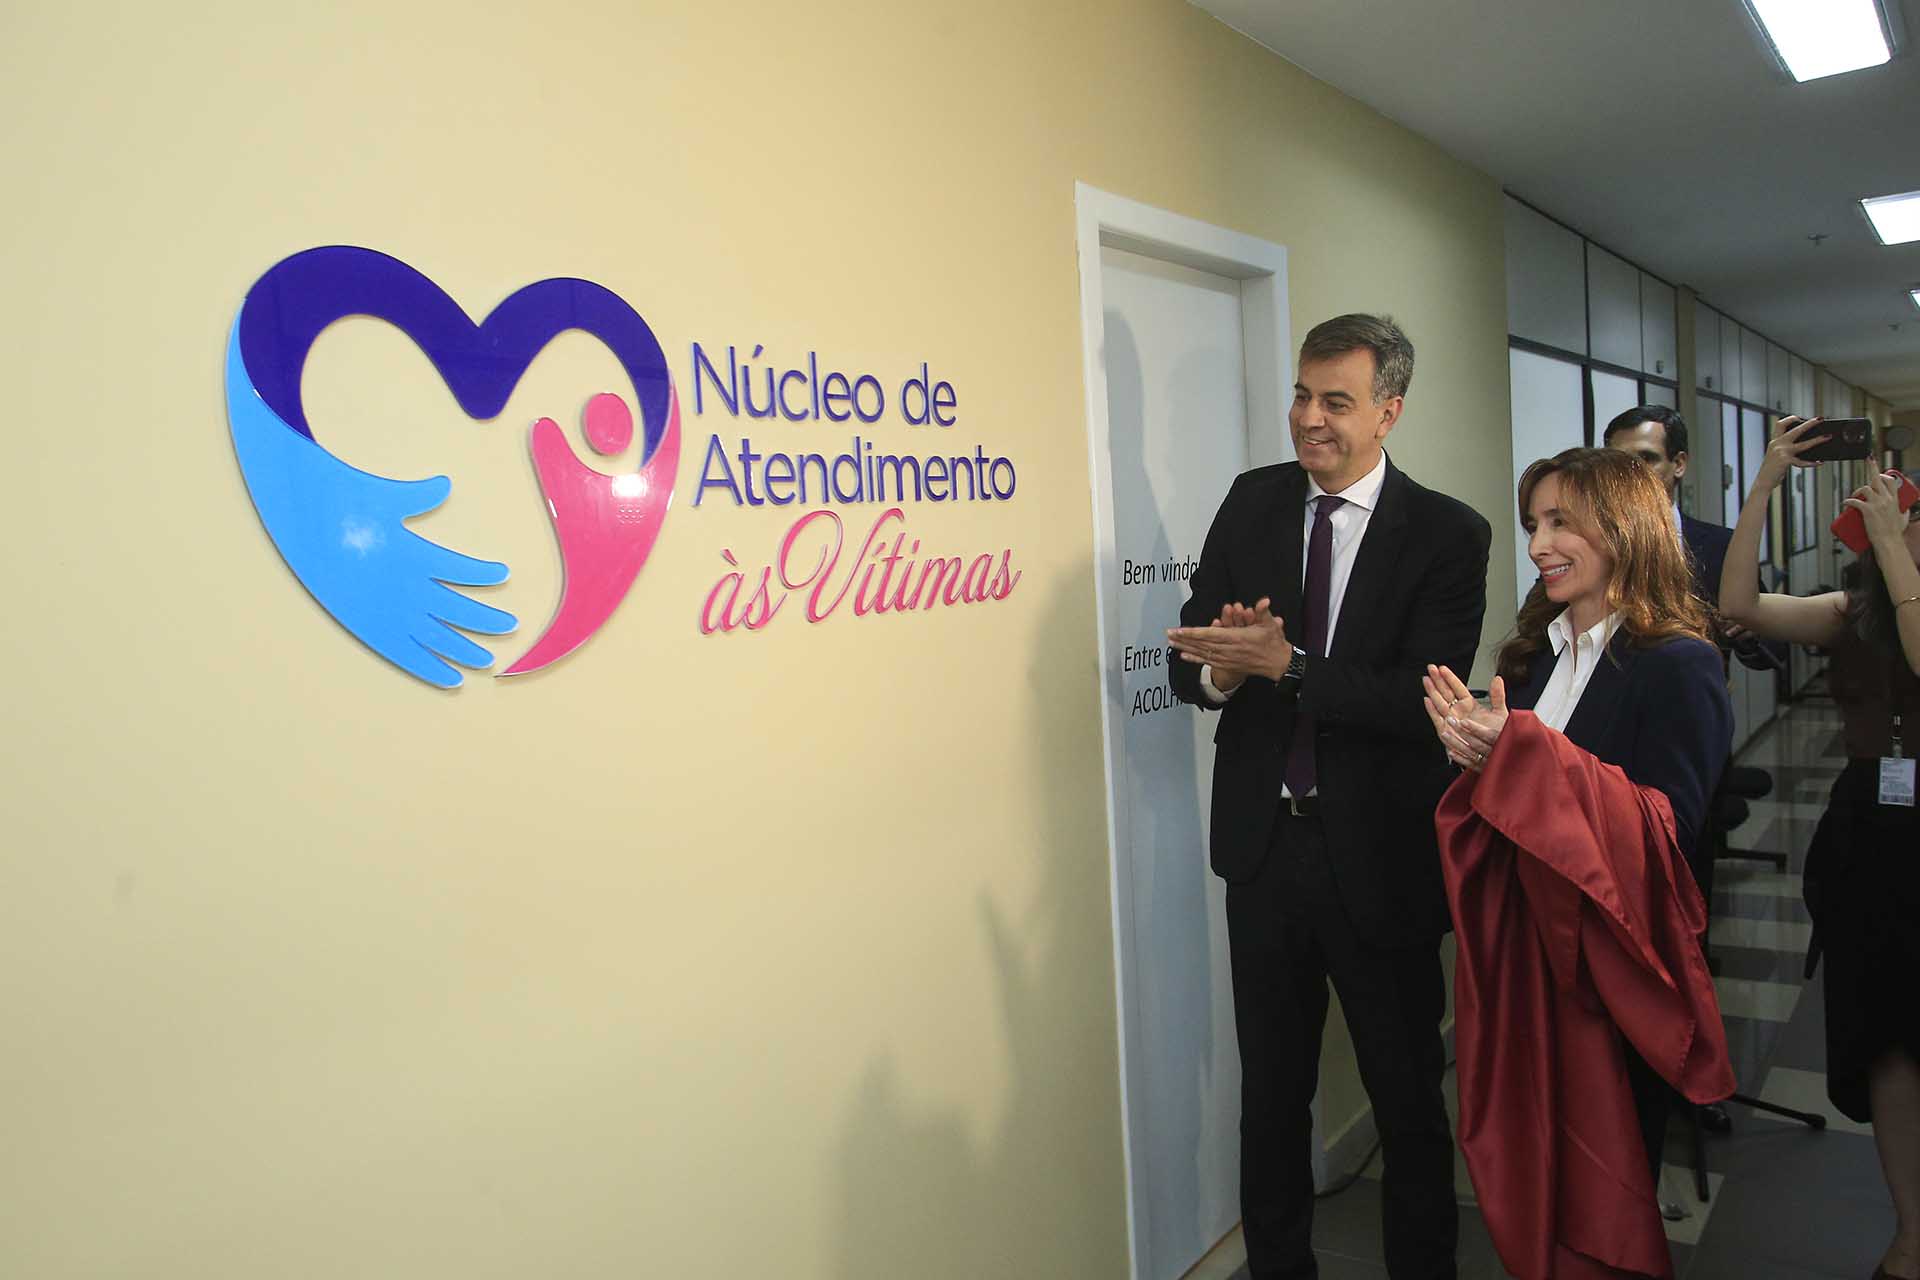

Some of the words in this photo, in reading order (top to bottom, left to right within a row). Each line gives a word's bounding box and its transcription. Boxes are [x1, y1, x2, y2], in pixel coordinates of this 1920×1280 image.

[692, 342, 885, 423] Núcleo
[900, 362, 957, 427] de
[692, 434, 1017, 507] Atendimento
[699, 549, 788, 635] às
[778, 507, 1022, 624] Vítimas
[1123, 559, 1156, 585] Bem
[1124, 646, 1162, 672] Entre
[1132, 684, 1183, 717] ACOLH
